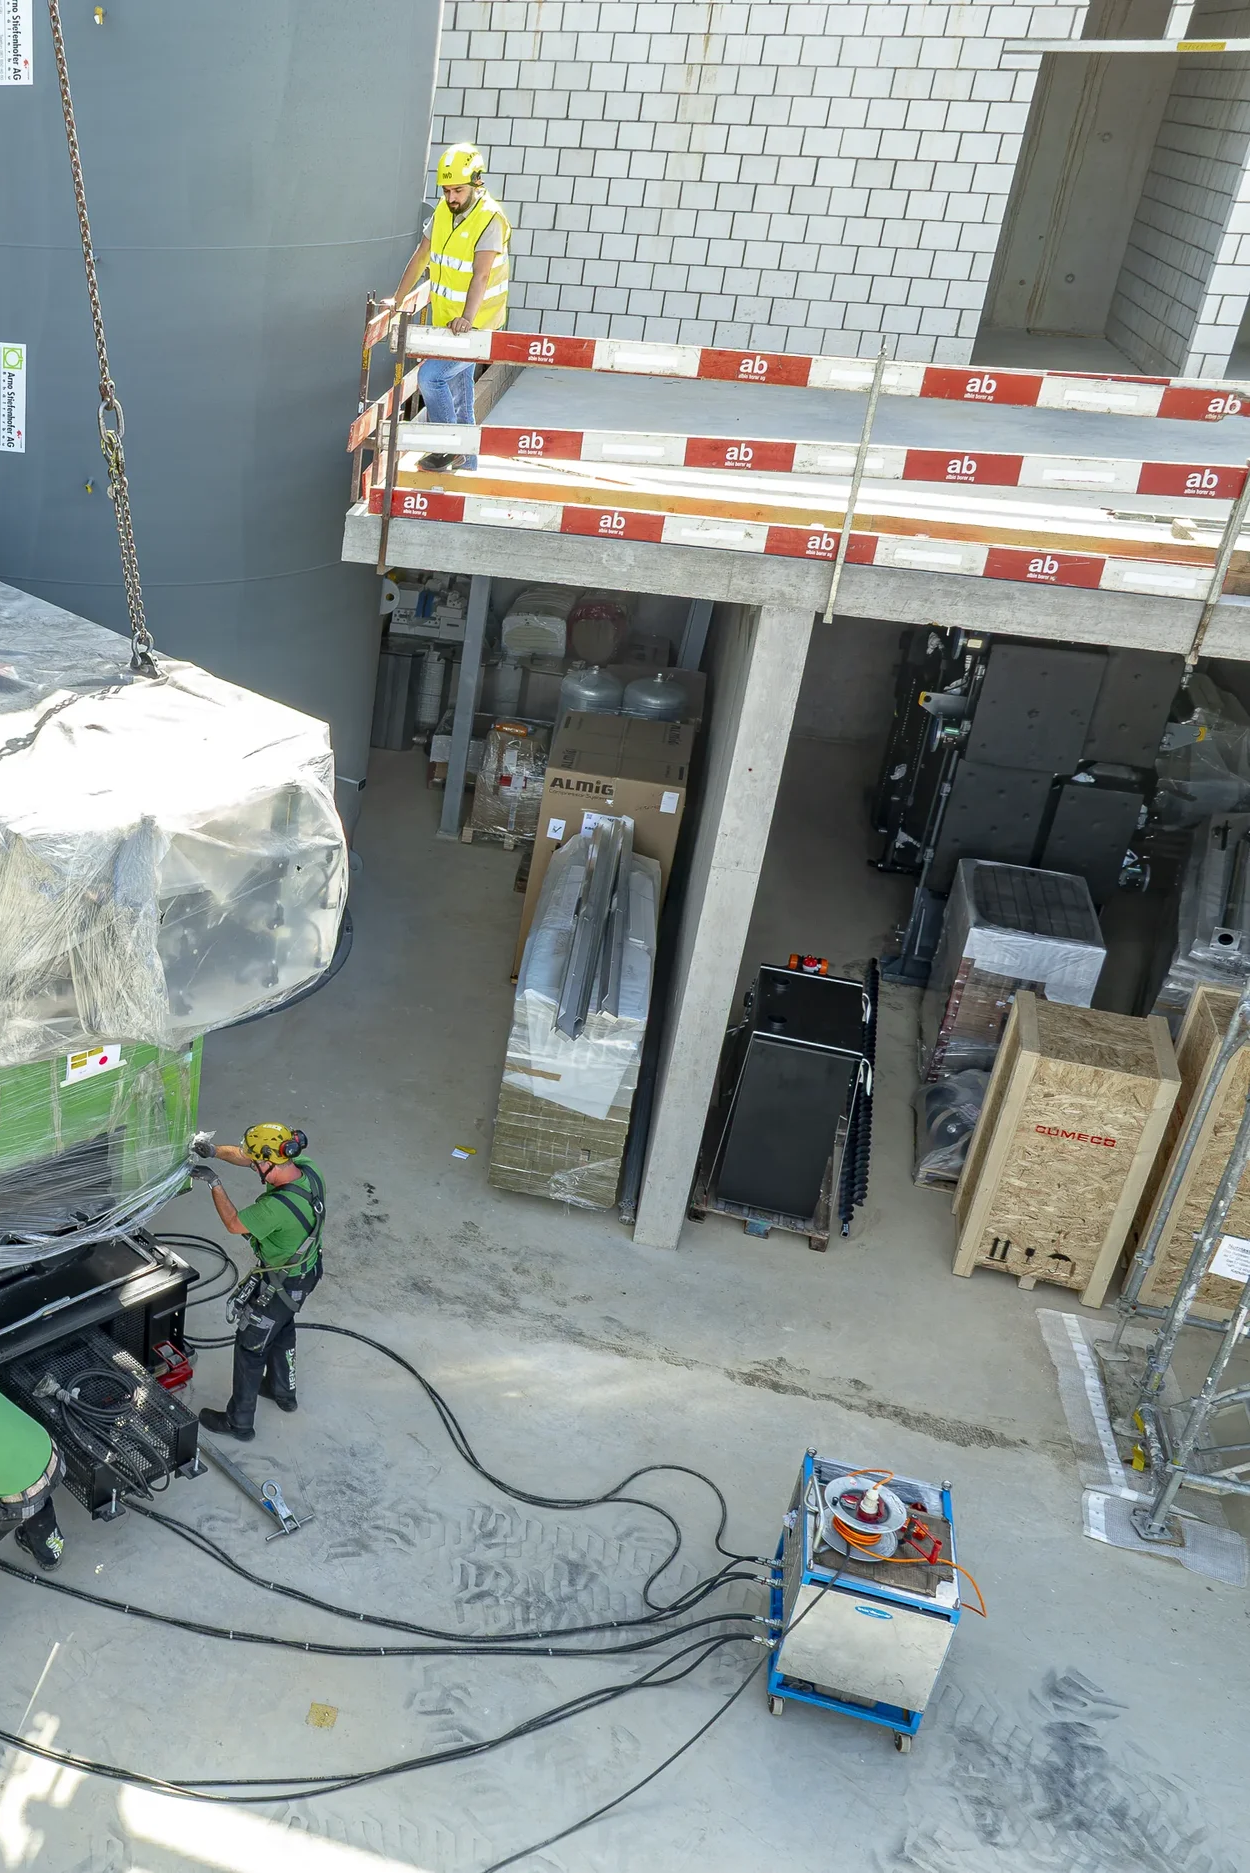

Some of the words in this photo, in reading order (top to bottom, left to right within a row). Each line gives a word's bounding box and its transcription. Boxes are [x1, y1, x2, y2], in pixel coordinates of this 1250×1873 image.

[12, 15, 22, 66] Stiefenhofer
[12, 67, 22, 81] AG
[528, 338, 555, 356] ab
[739, 356, 768, 374] ab
[7, 371, 15, 390] Arno
[965, 374, 997, 393] ab
[7, 391, 16, 435] Stiefenhofer
[1208, 394, 1241, 414] ab
[7, 436, 15, 448] AG
[518, 432, 544, 449] ab
[726, 443, 753, 461] ab
[947, 456, 977, 475] ab
[1186, 469, 1218, 488] ab
[403, 494, 428, 510] ab
[599, 511, 626, 530] ab
[807, 533, 835, 551] ab
[1028, 555, 1059, 574] ab
